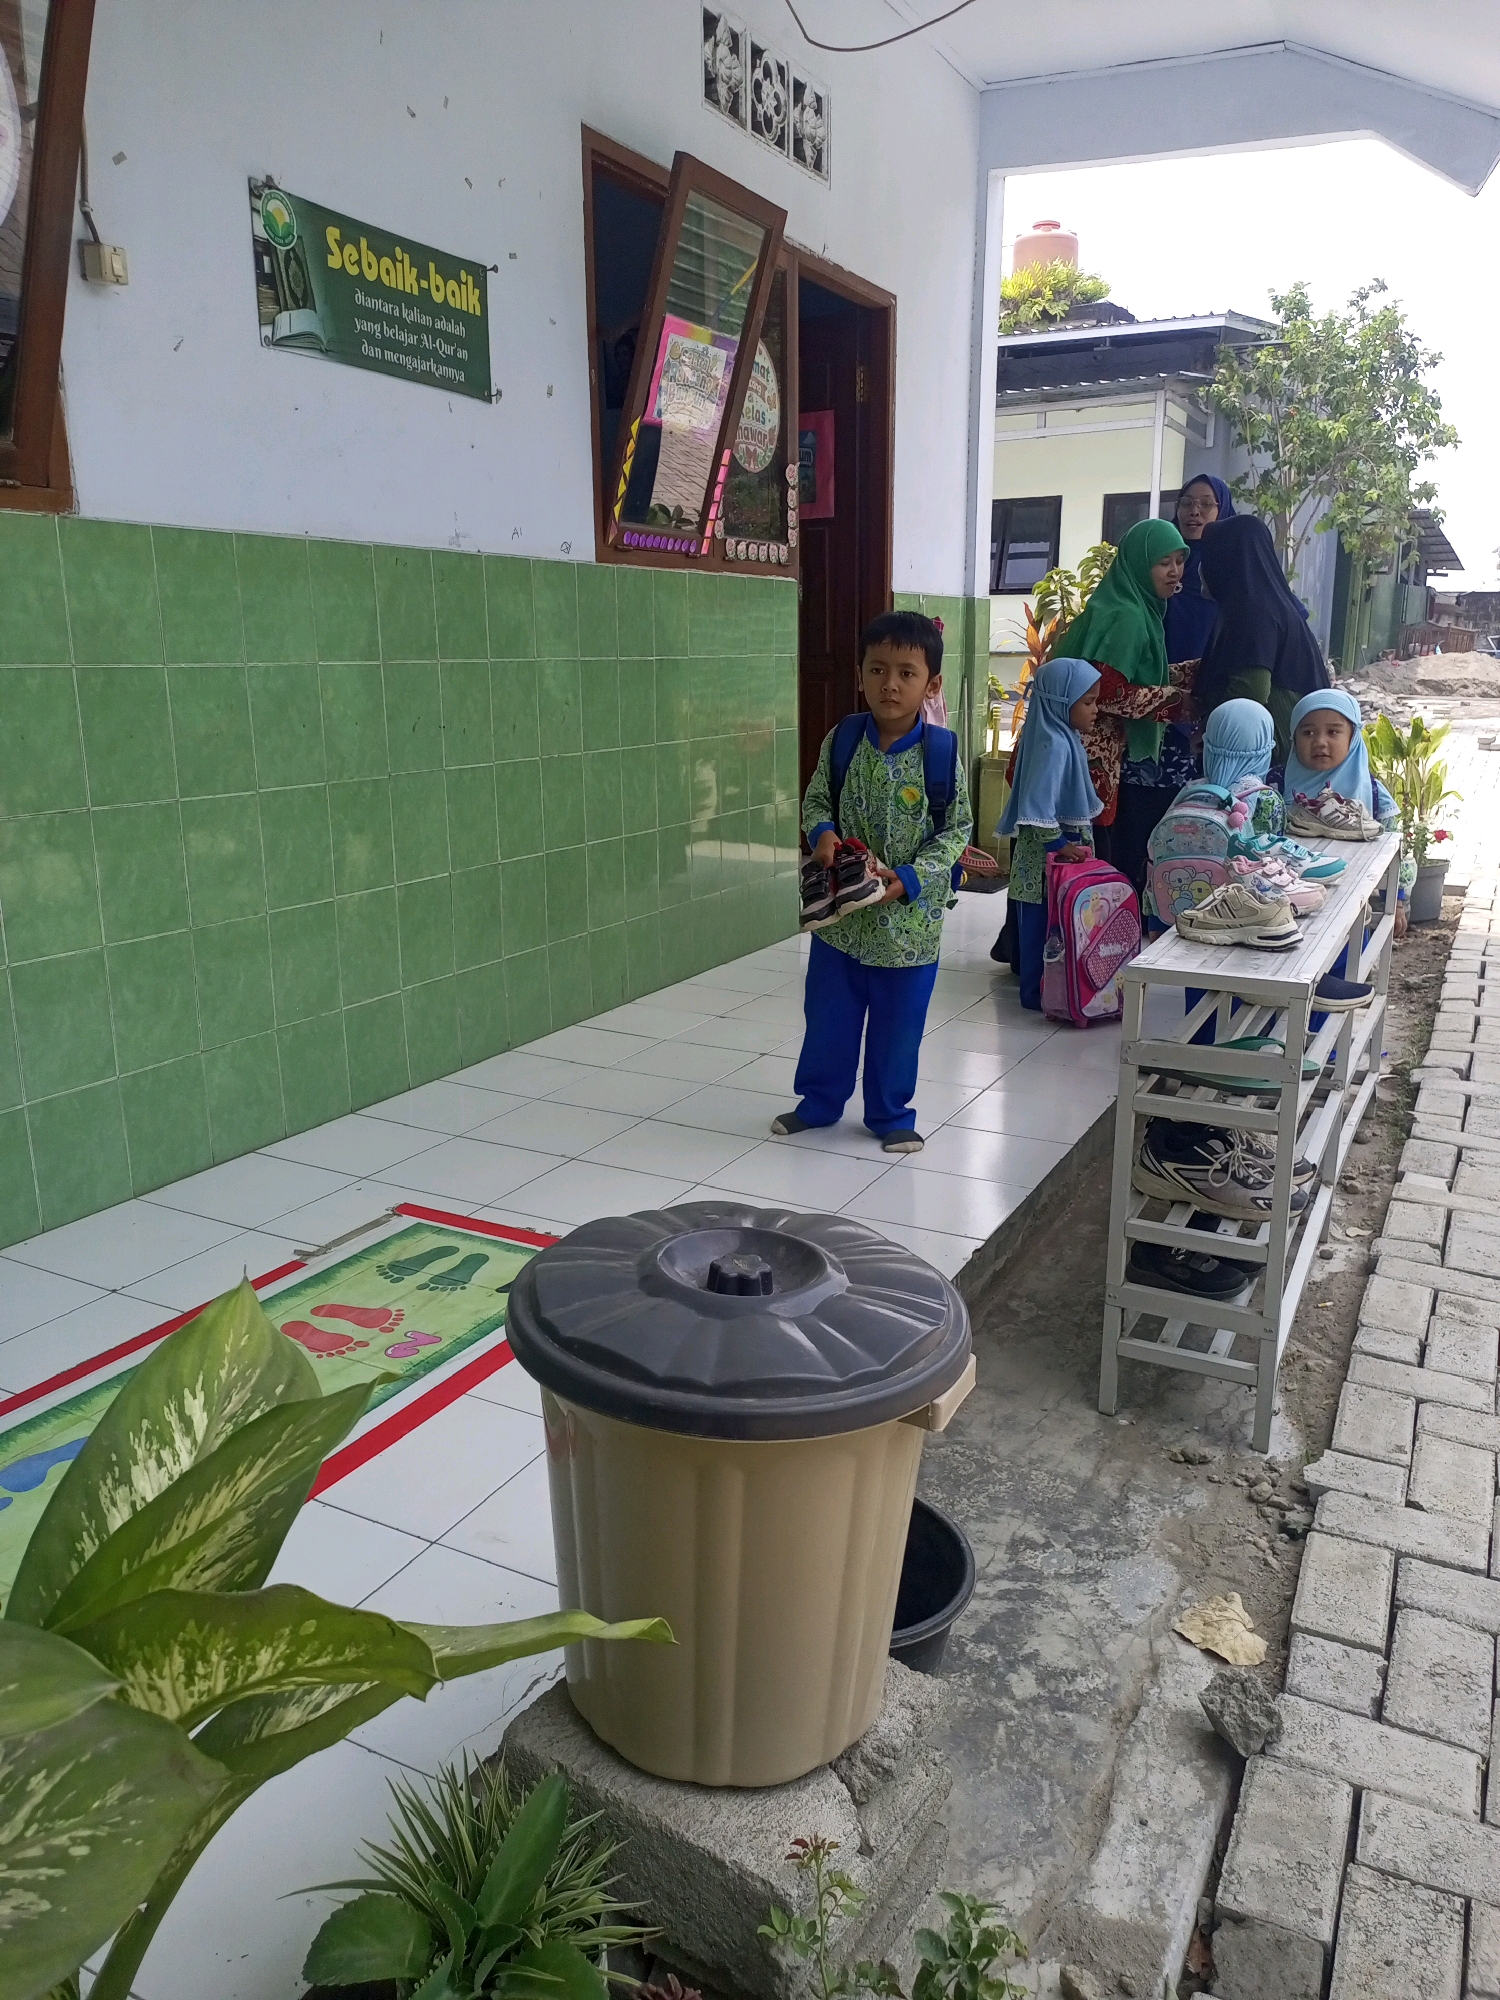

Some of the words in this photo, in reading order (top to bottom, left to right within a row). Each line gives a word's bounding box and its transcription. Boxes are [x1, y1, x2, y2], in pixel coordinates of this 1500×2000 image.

[325, 226, 481, 316] Sebaik-baik
[355, 288, 400, 317] diantara
[402, 303, 433, 328] kalian
[435, 316, 466, 338] adalah
[354, 317, 382, 339] yang
[383, 321, 418, 346] belajar
[420, 333, 468, 361] Al-Qur'an
[361, 339, 382, 359] dan
[384, 349, 465, 383] mengajarkannya
[741, 405, 766, 425] elas
